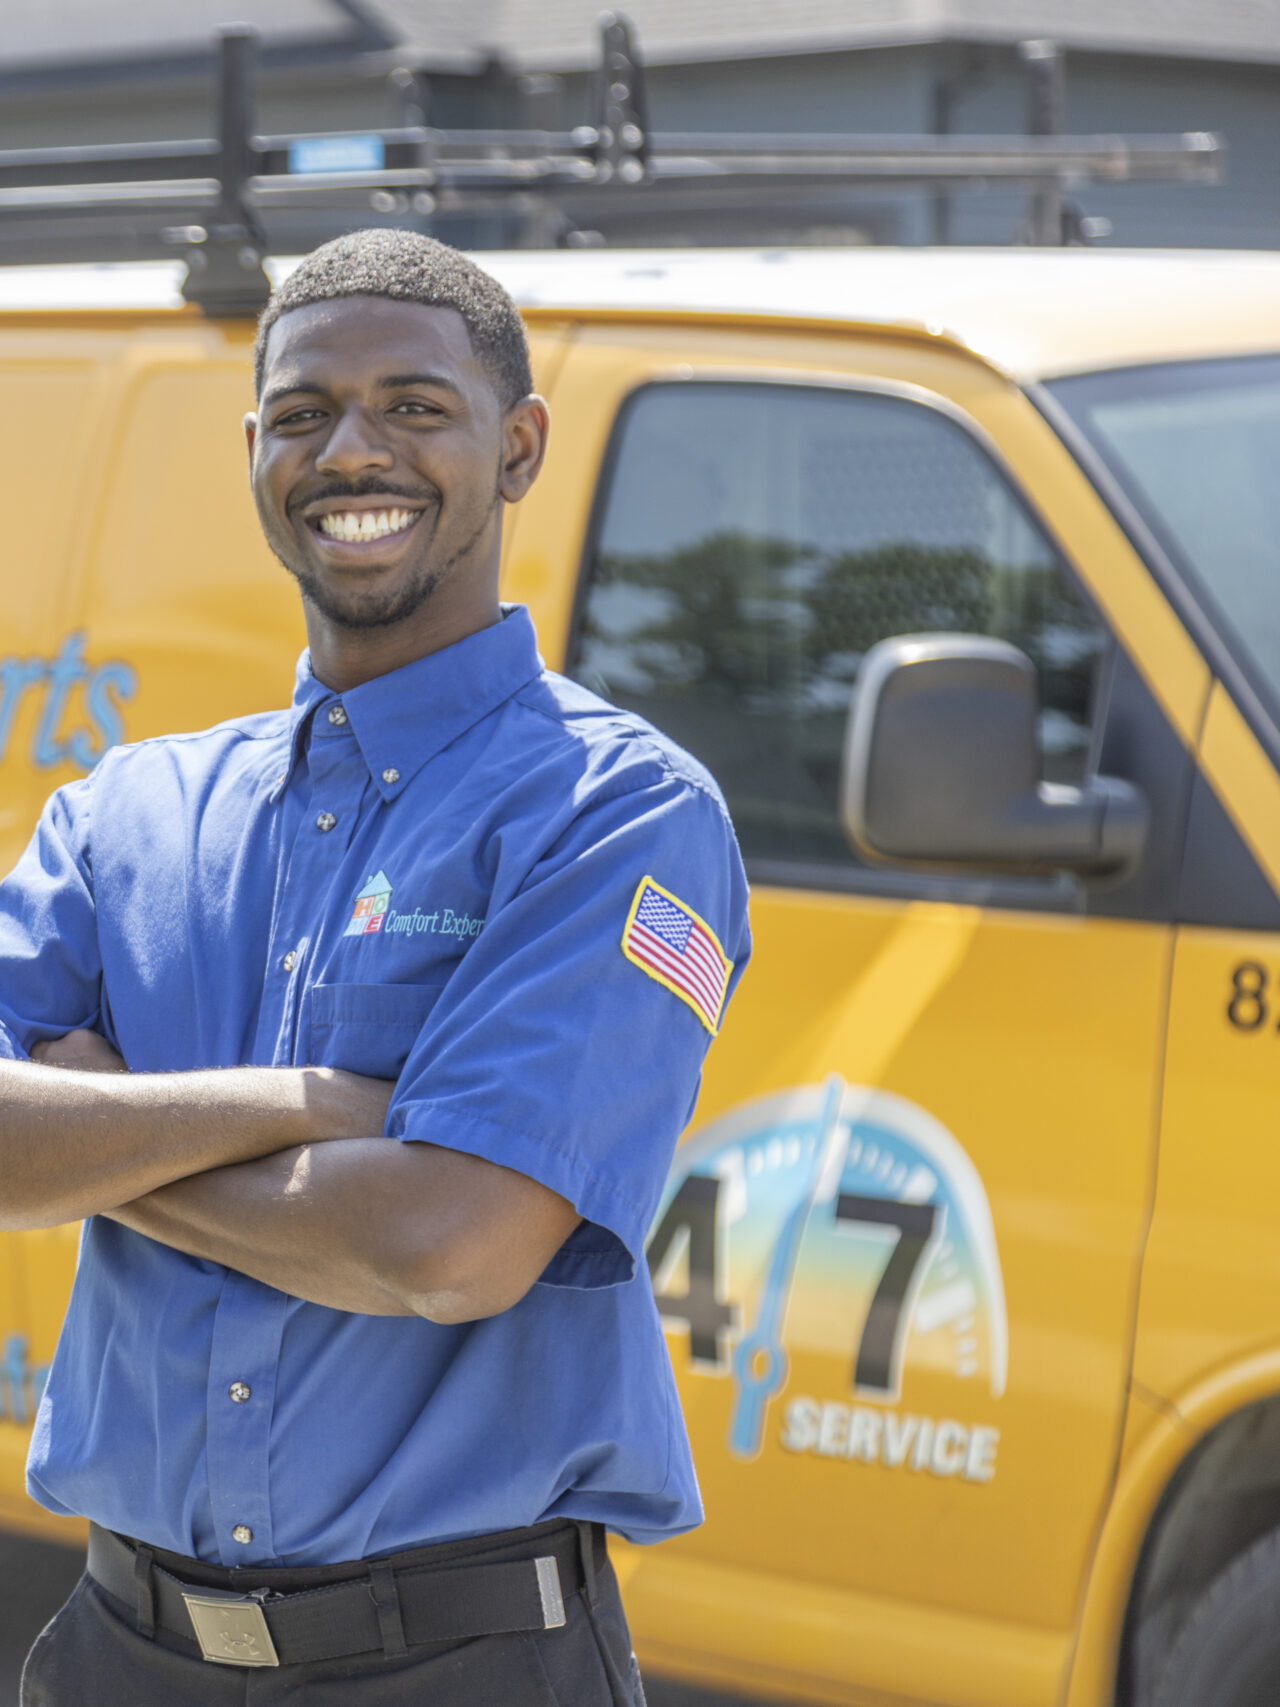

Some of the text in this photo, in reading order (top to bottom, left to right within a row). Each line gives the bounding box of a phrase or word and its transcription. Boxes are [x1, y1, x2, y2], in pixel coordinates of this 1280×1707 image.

[385, 907, 439, 936] Comfort
[1227, 959, 1280, 1033] 8
[782, 1397, 1000, 1484] SERVICE
